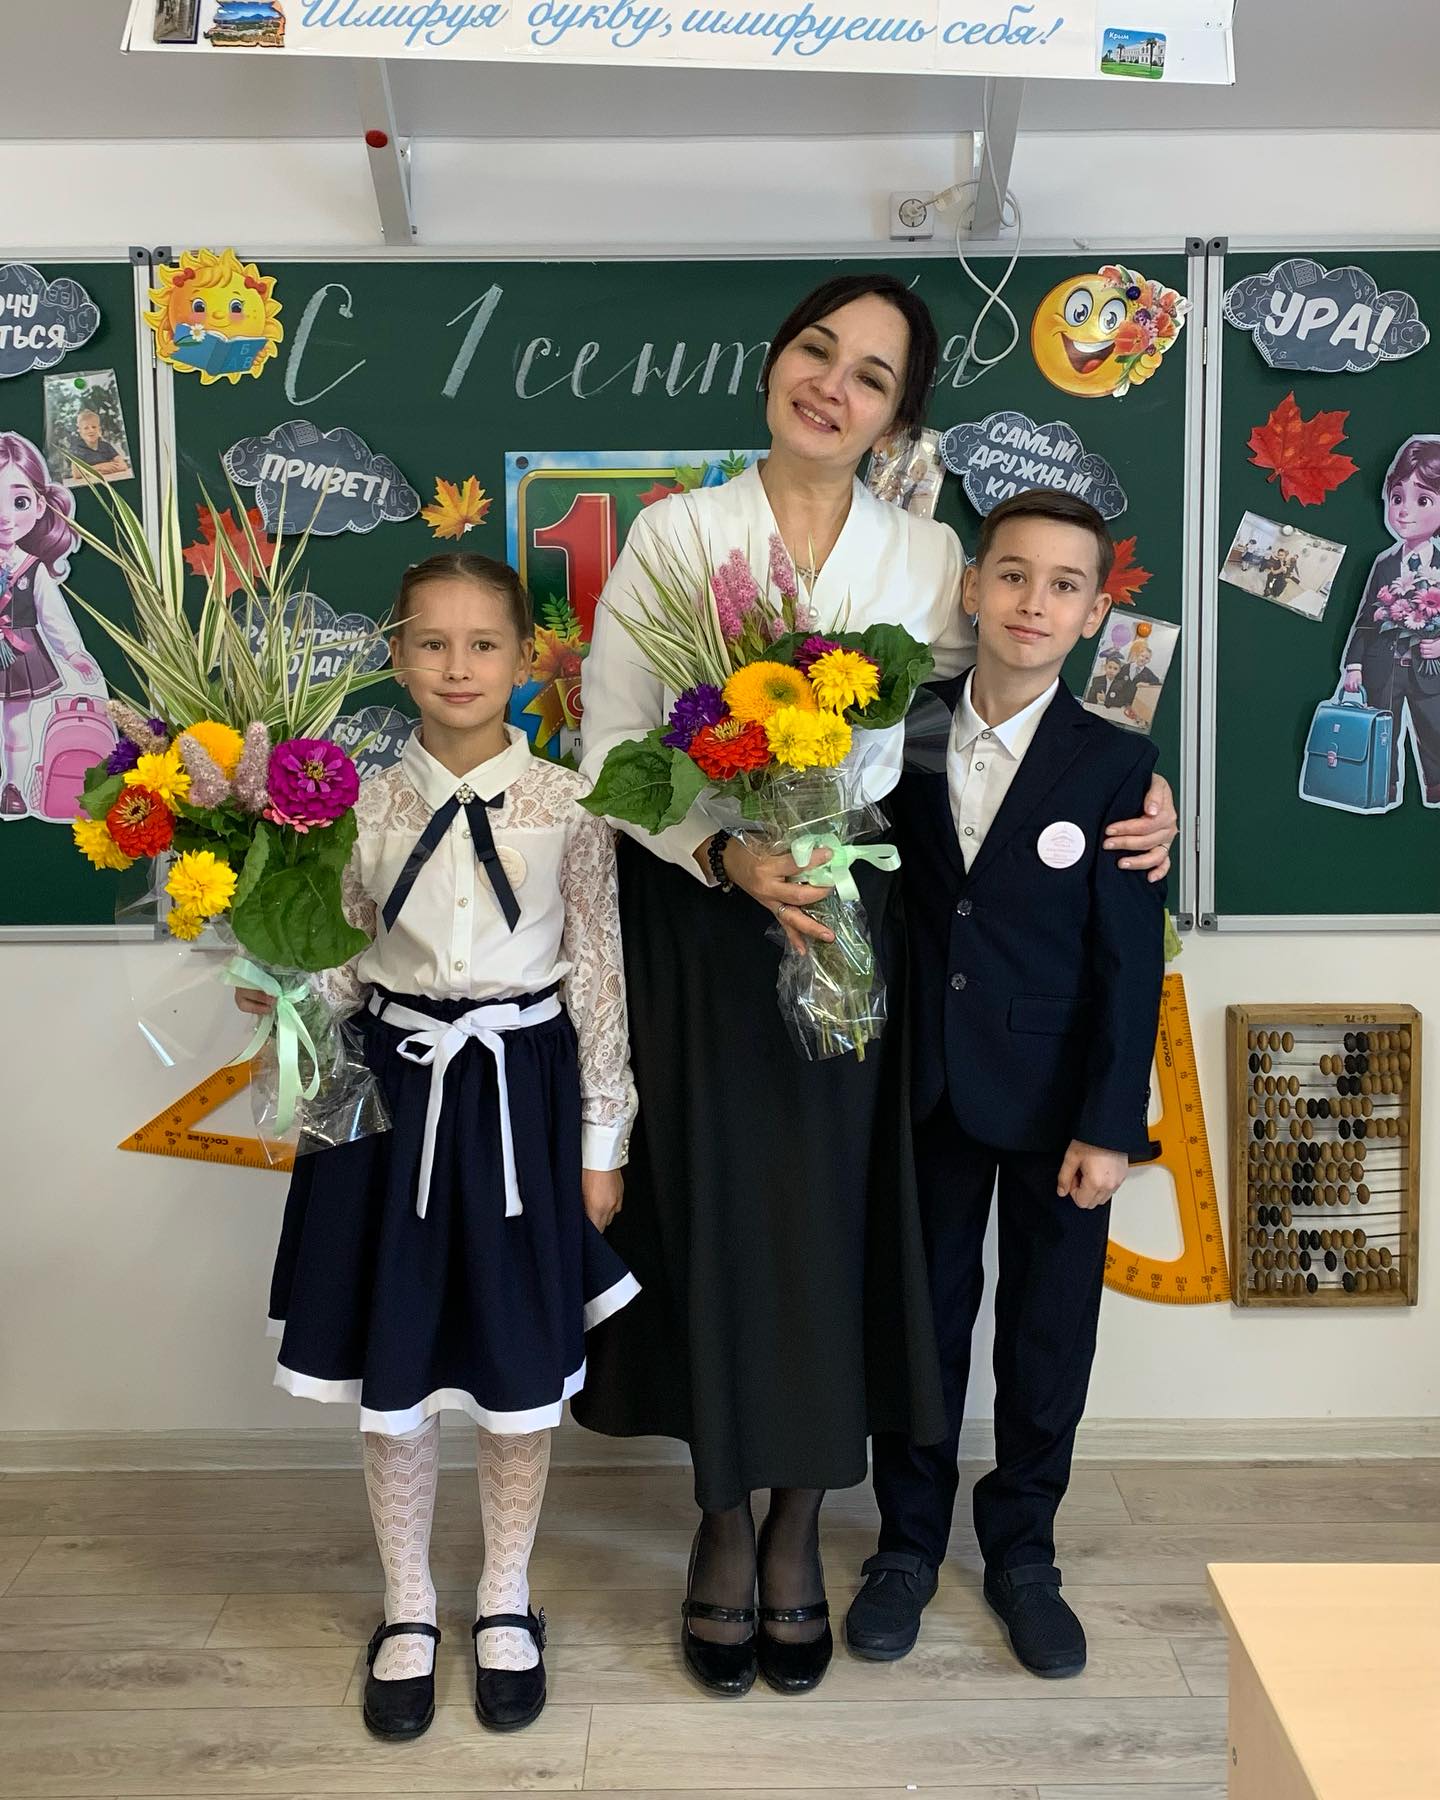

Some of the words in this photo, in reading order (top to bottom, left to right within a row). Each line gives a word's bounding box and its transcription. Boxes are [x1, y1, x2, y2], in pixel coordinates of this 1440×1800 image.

[682, 1, 936, 56] шлифуешь
[942, 3, 1064, 46] себя!
[441, 283, 503, 400] 1
[1264, 289, 1396, 354] УРА!
[989, 421, 1079, 464] САМЫЙ
[260, 453, 391, 507] ПРИВЕТ!
[967, 444, 1094, 497] ДРУЖНЫЙ
